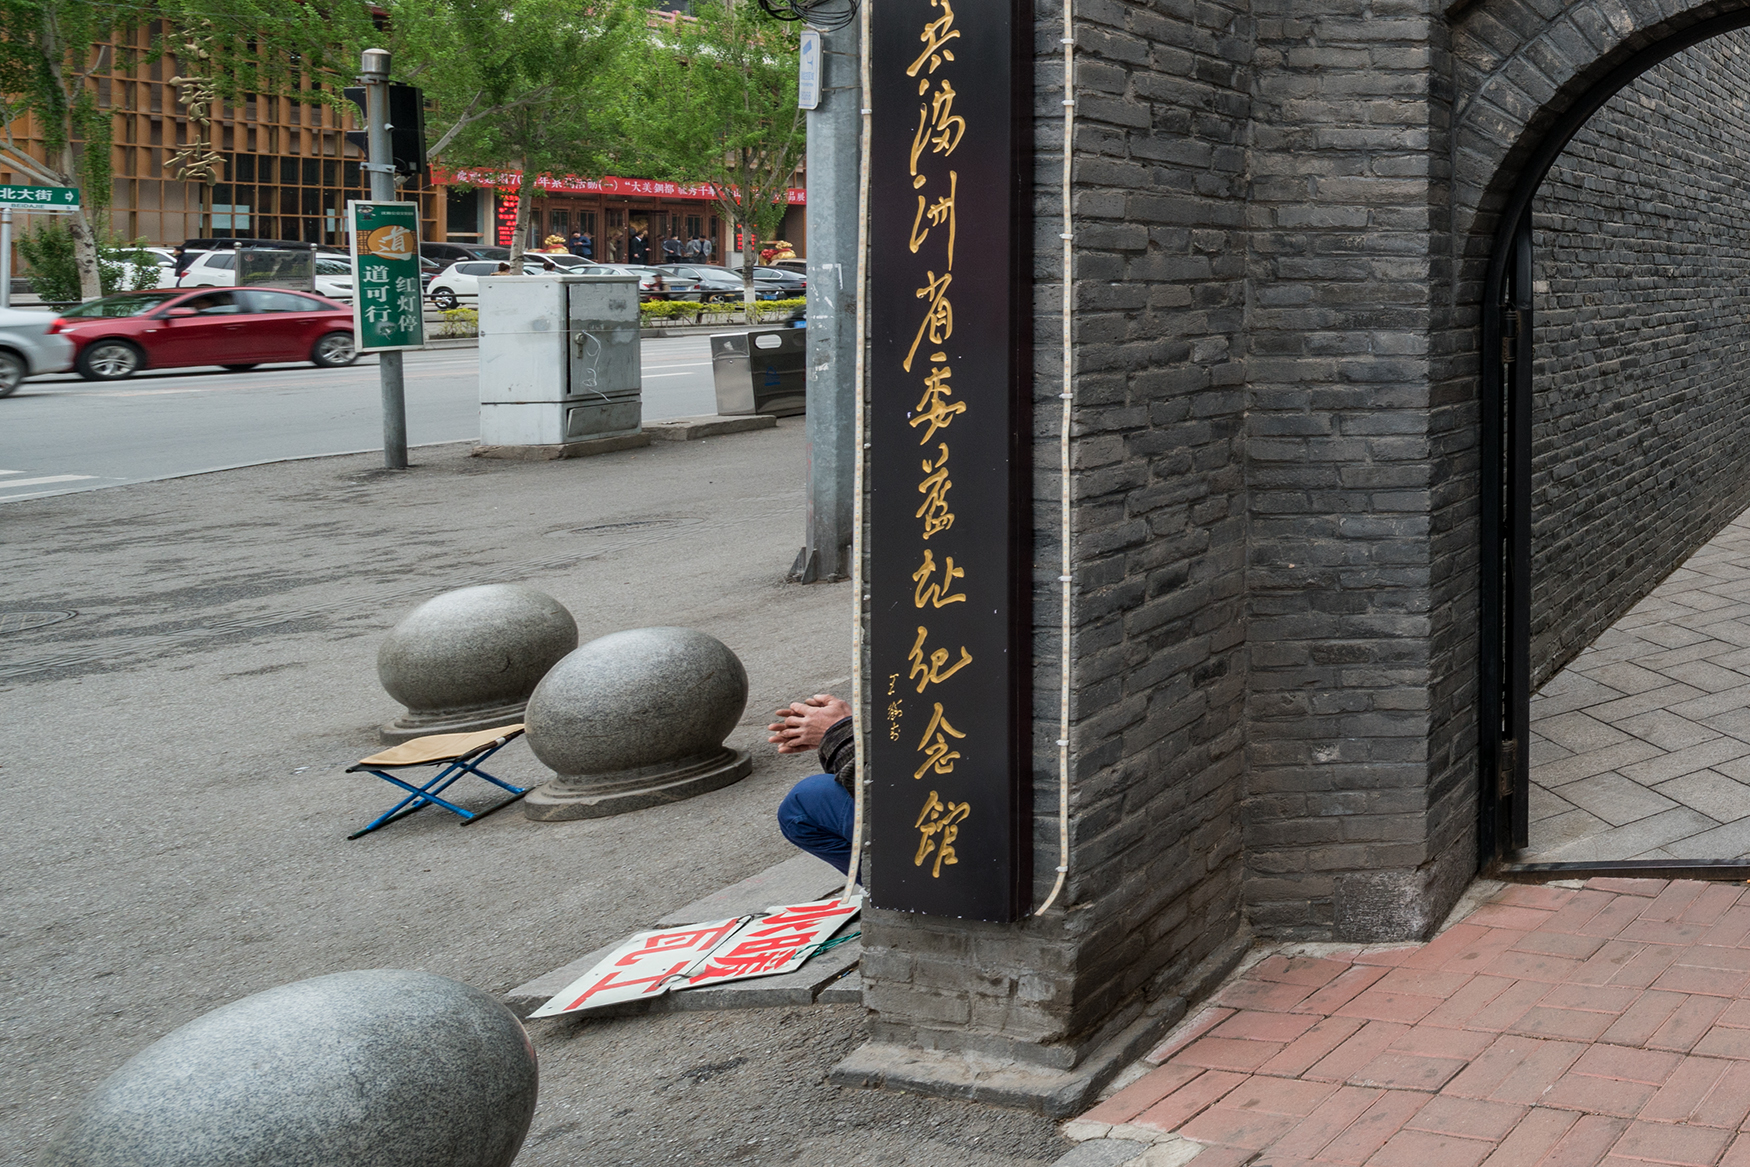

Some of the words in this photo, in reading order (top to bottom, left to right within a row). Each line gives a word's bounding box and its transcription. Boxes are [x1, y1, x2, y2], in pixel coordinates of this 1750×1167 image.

[0, 187, 53, 202] 北大街
[363, 265, 392, 323] 道可行
[395, 276, 418, 332] 红灯停
